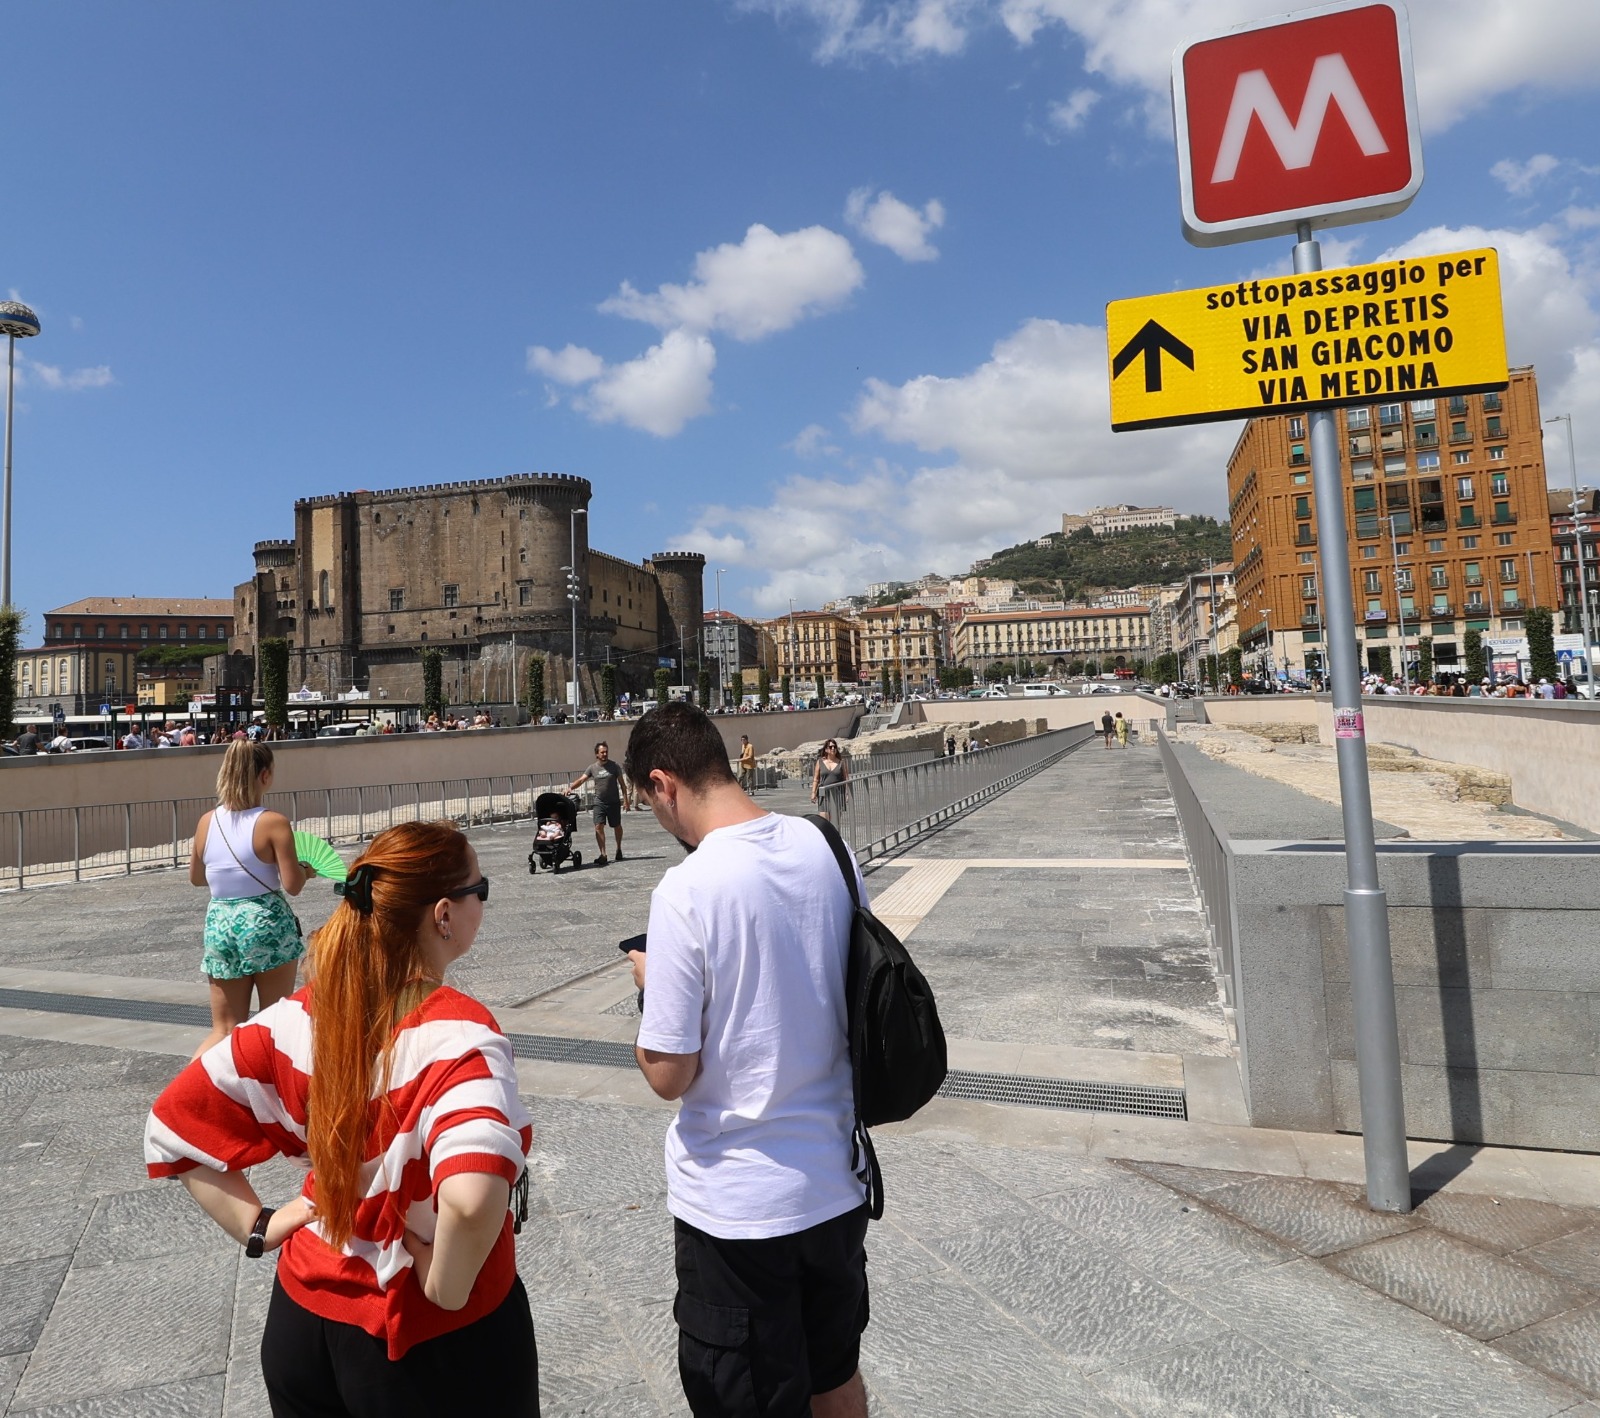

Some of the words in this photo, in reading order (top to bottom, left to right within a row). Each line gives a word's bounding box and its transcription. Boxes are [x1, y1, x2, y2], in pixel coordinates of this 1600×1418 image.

[1210, 52, 1390, 184] M
[1207, 261, 1426, 310] sottopassaggio
[1438, 256, 1486, 287] per
[1242, 314, 1292, 343] VIA
[1303, 293, 1450, 335] DEPRETIS
[1241, 345, 1299, 375] SAN
[1311, 326, 1454, 367] GIACOMO
[1258, 376, 1309, 406] VIA
[1320, 361, 1440, 399] MEDINA
